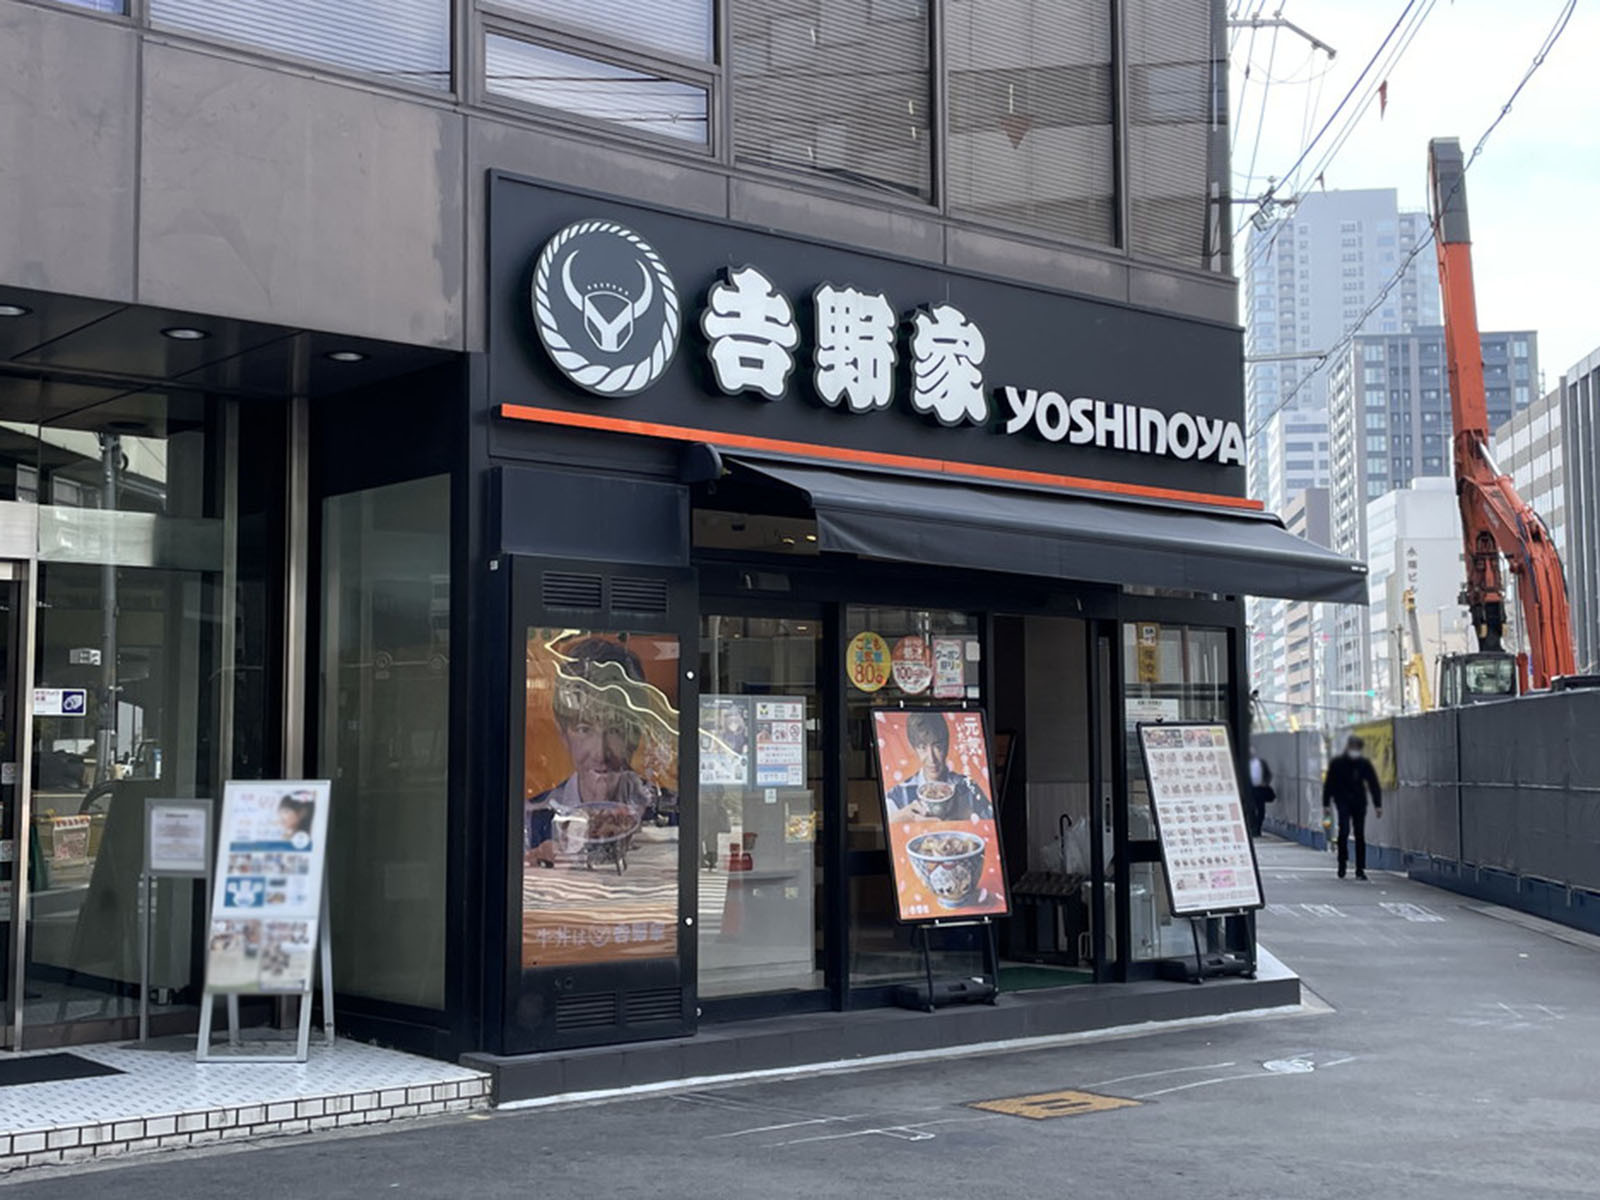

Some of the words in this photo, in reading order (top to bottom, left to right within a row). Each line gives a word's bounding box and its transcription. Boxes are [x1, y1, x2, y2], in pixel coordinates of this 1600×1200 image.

[703, 266, 989, 424] 吉野家
[1004, 385, 1246, 467] YOSHINOYA
